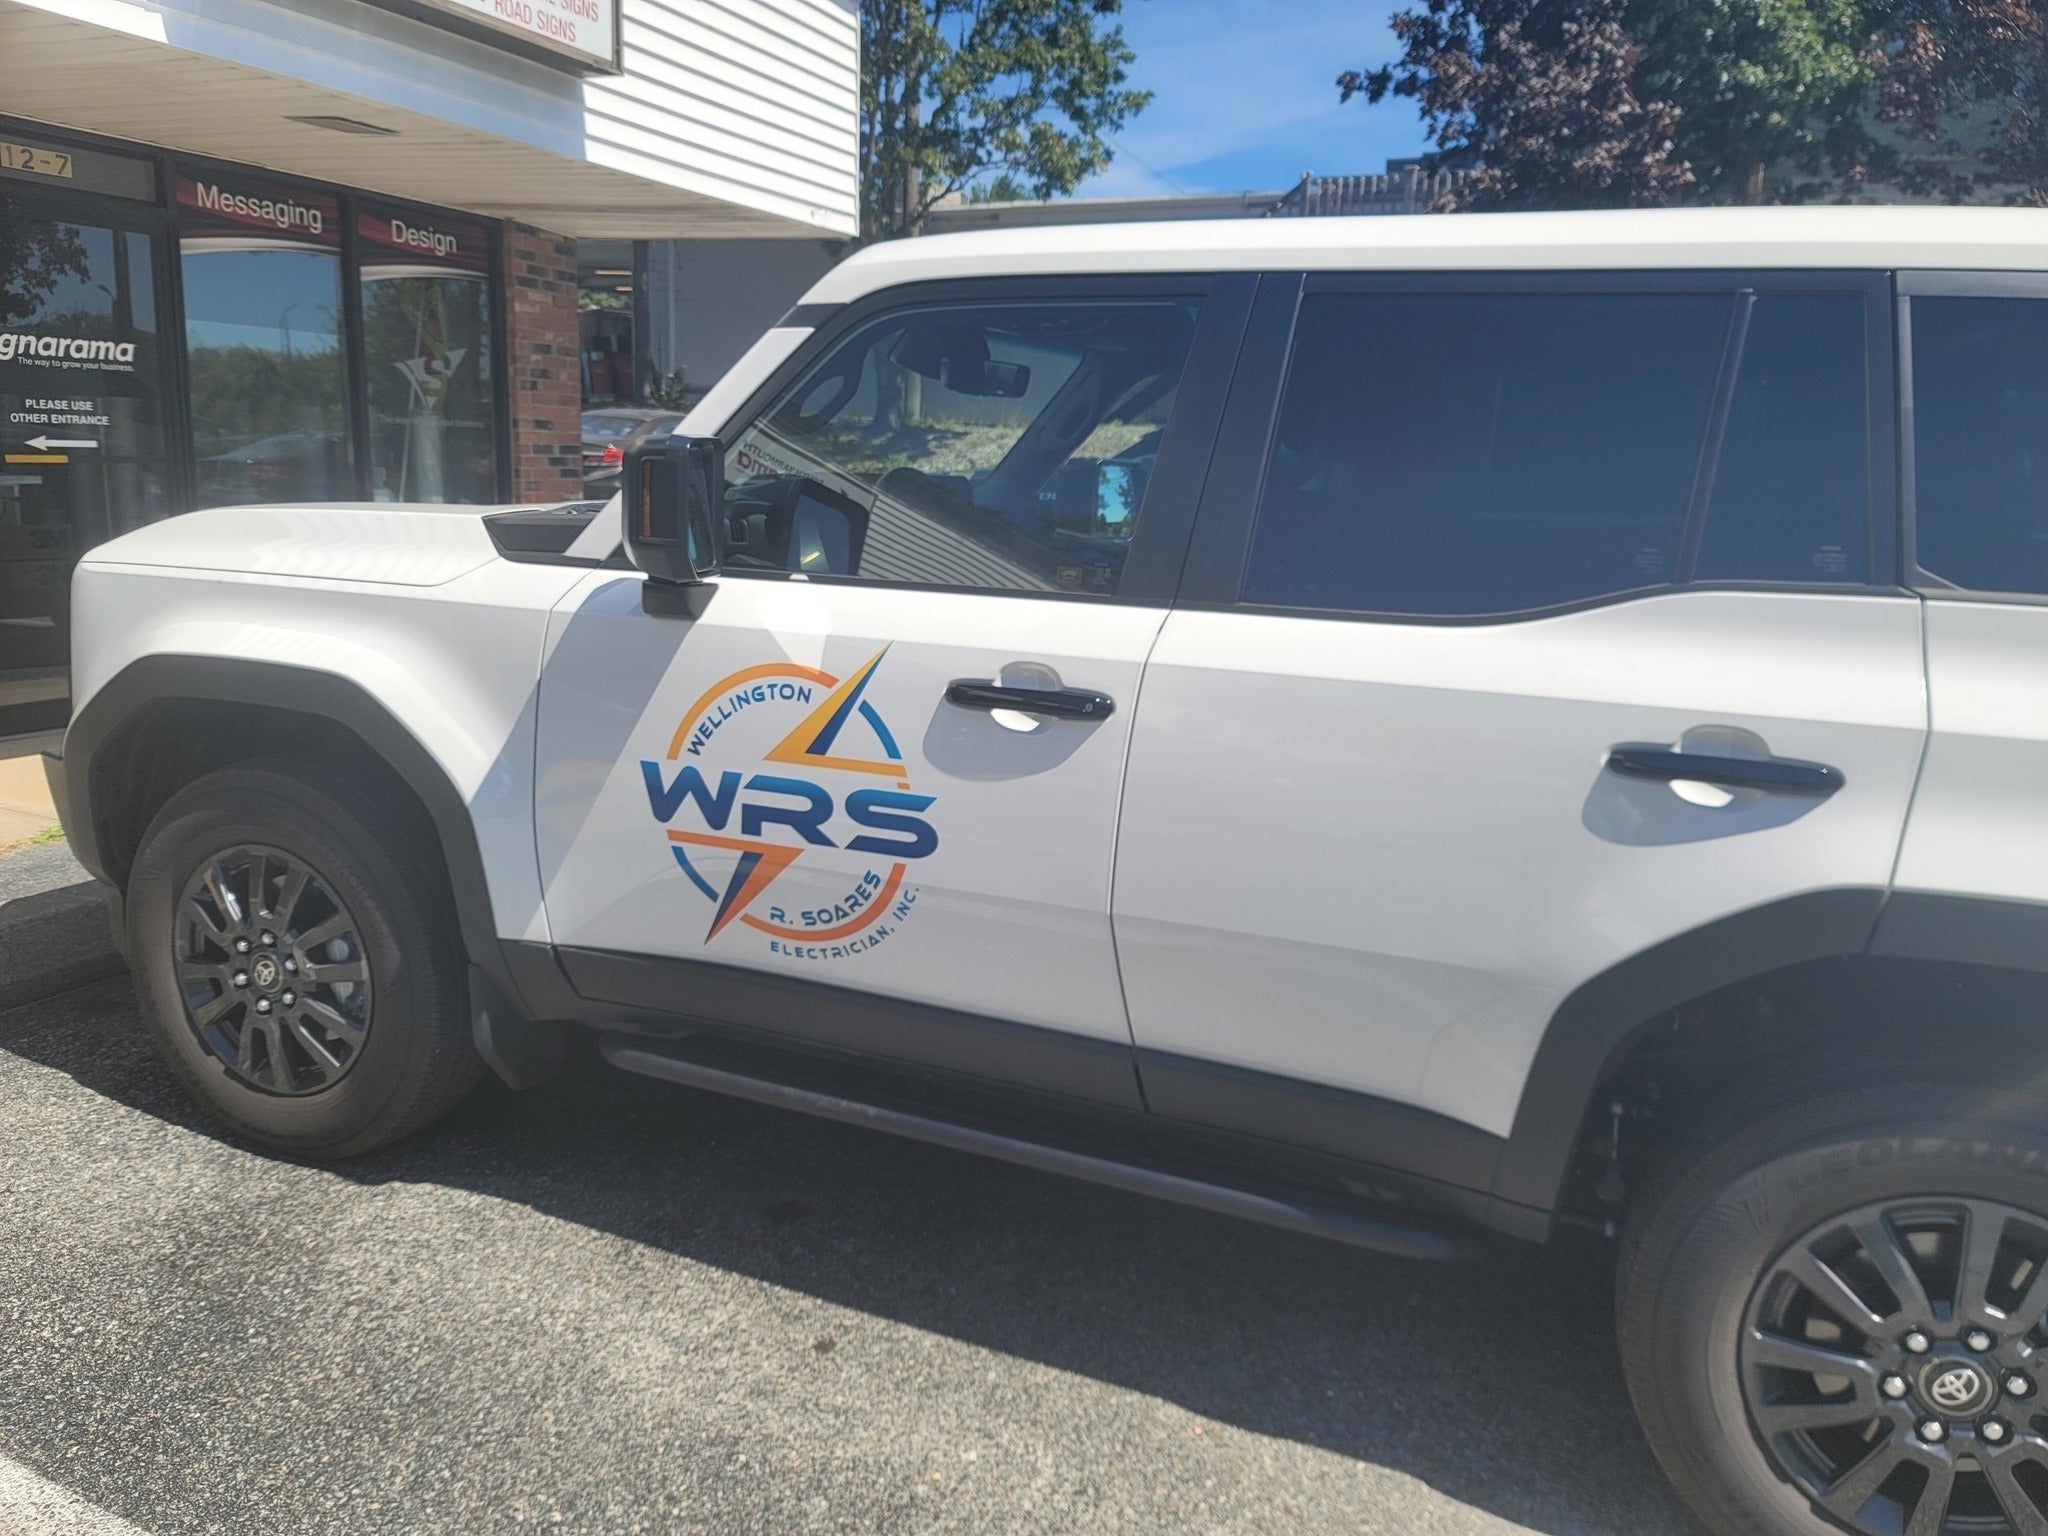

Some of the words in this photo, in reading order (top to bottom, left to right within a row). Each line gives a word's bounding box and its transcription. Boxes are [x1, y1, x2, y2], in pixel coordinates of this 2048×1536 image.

[495, 0, 532, 25] ROAD
[536, 10, 577, 42] SIGNS
[6, 145, 69, 175] 12-7
[196, 182, 322, 235] Messaging
[391, 219, 457, 254] Design
[18, 356, 33, 366] The
[34, 358, 50, 368] way
[52, 359, 60, 367] to
[61, 360, 81, 369] grow
[10, 413, 49, 424] OTHER
[51, 414, 111, 426] ENTRANCE
[25, 398, 69, 410] PLEASE
[71, 400, 94, 411] USE
[687, 683, 812, 756] WELLINGTON
[640, 760, 939, 859] WRS
[770, 906, 794, 925] R.
[801, 869, 881, 926] SOARES
[770, 925, 895, 960] ELECTRICIAN,
[893, 888, 920, 922] INC.
